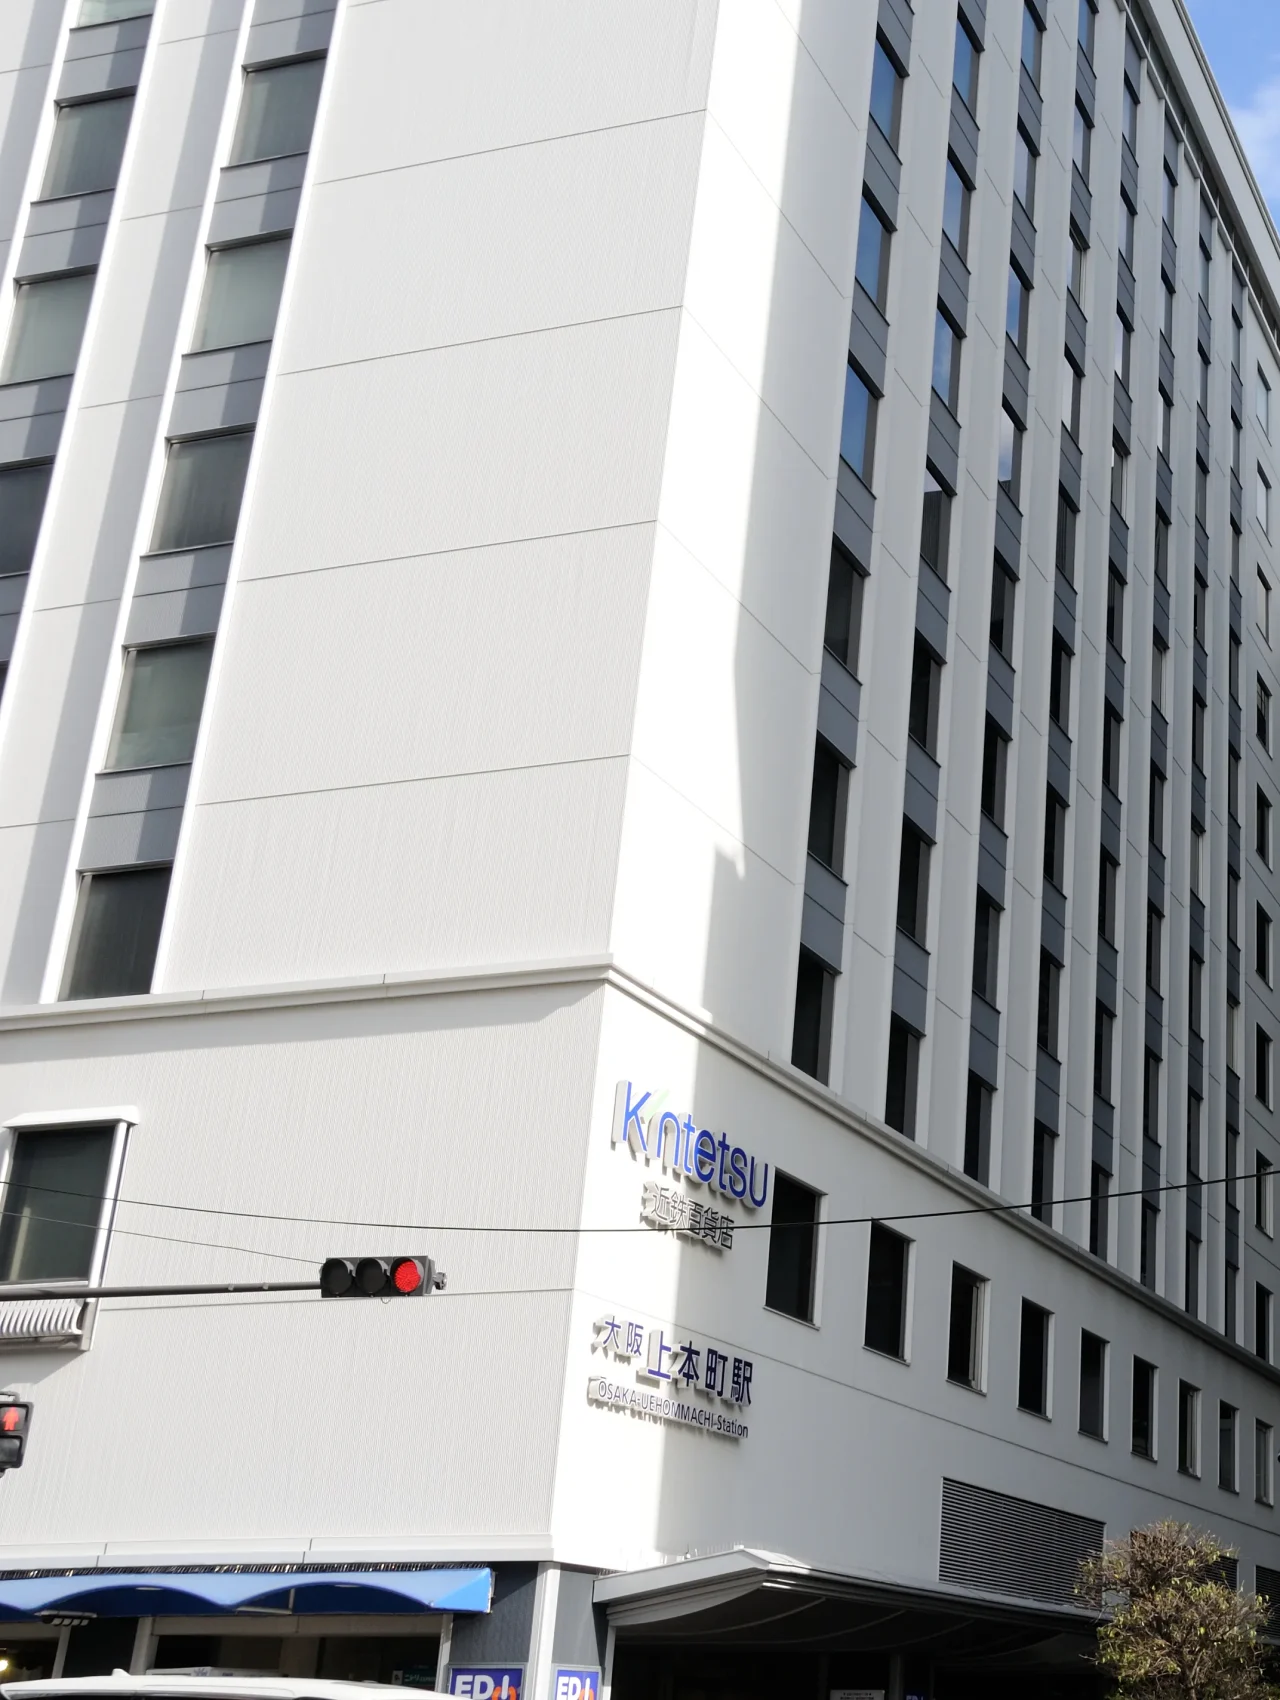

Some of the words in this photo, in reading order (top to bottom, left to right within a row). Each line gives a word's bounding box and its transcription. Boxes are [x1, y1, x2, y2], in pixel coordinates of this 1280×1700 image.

[650, 1184, 735, 1251] 近鉄百貨店
[602, 1314, 754, 1407] 大阪上本町駅
[716, 1414, 750, 1439] Station
